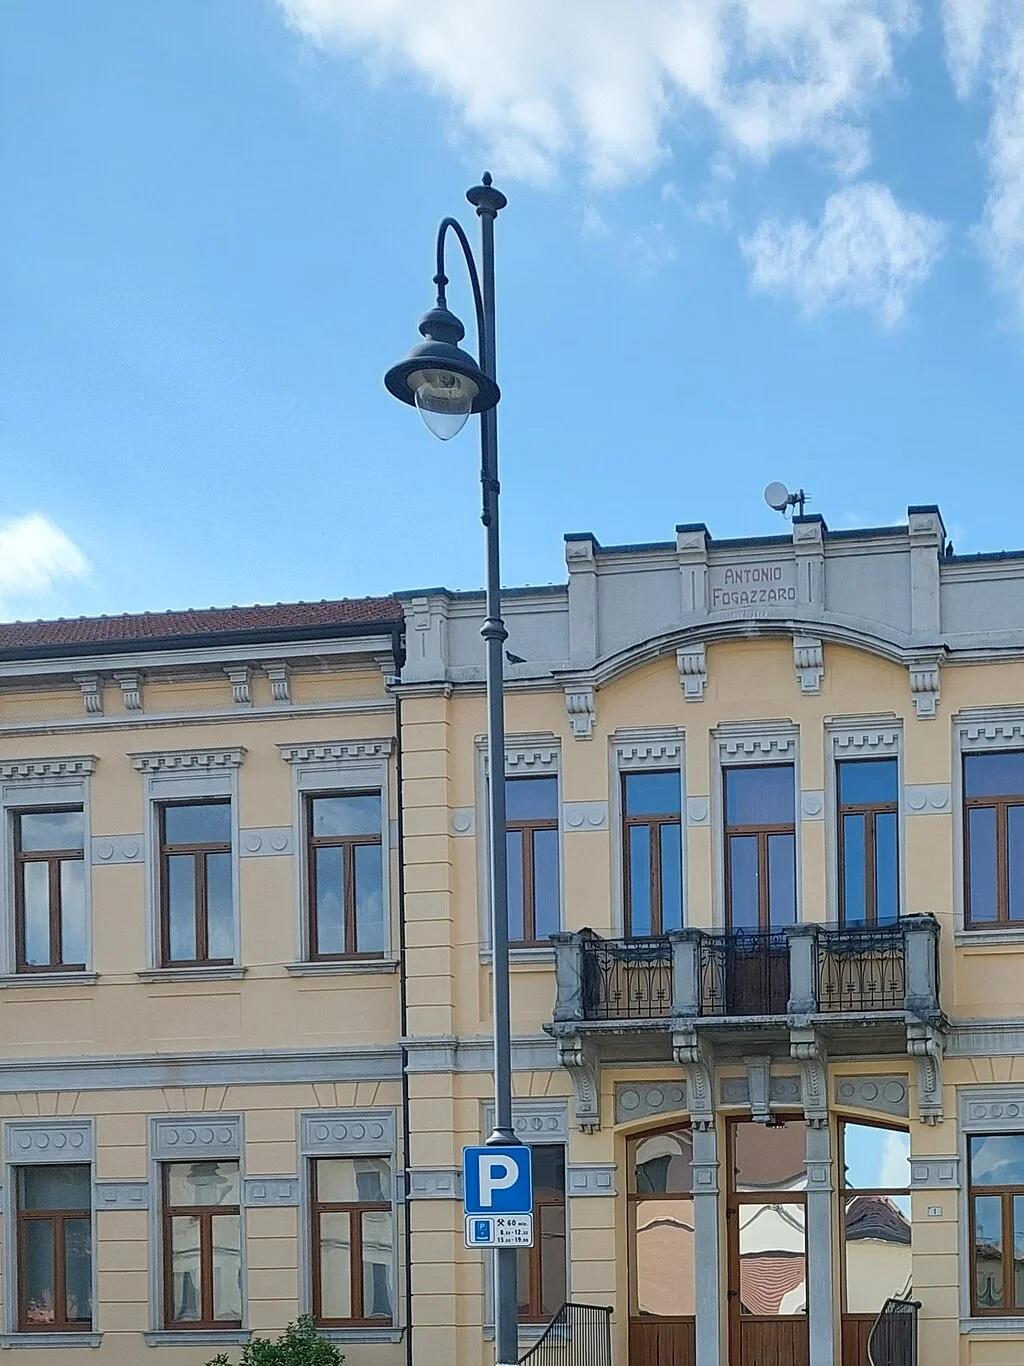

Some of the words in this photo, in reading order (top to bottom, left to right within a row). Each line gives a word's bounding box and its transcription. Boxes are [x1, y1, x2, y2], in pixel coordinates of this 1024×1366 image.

[725, 567, 782, 584] ANTONIO
[713, 587, 796, 606] FOGAZZARO
[478, 1154, 519, 1207] P
[507, 1219, 517, 1227] 60
